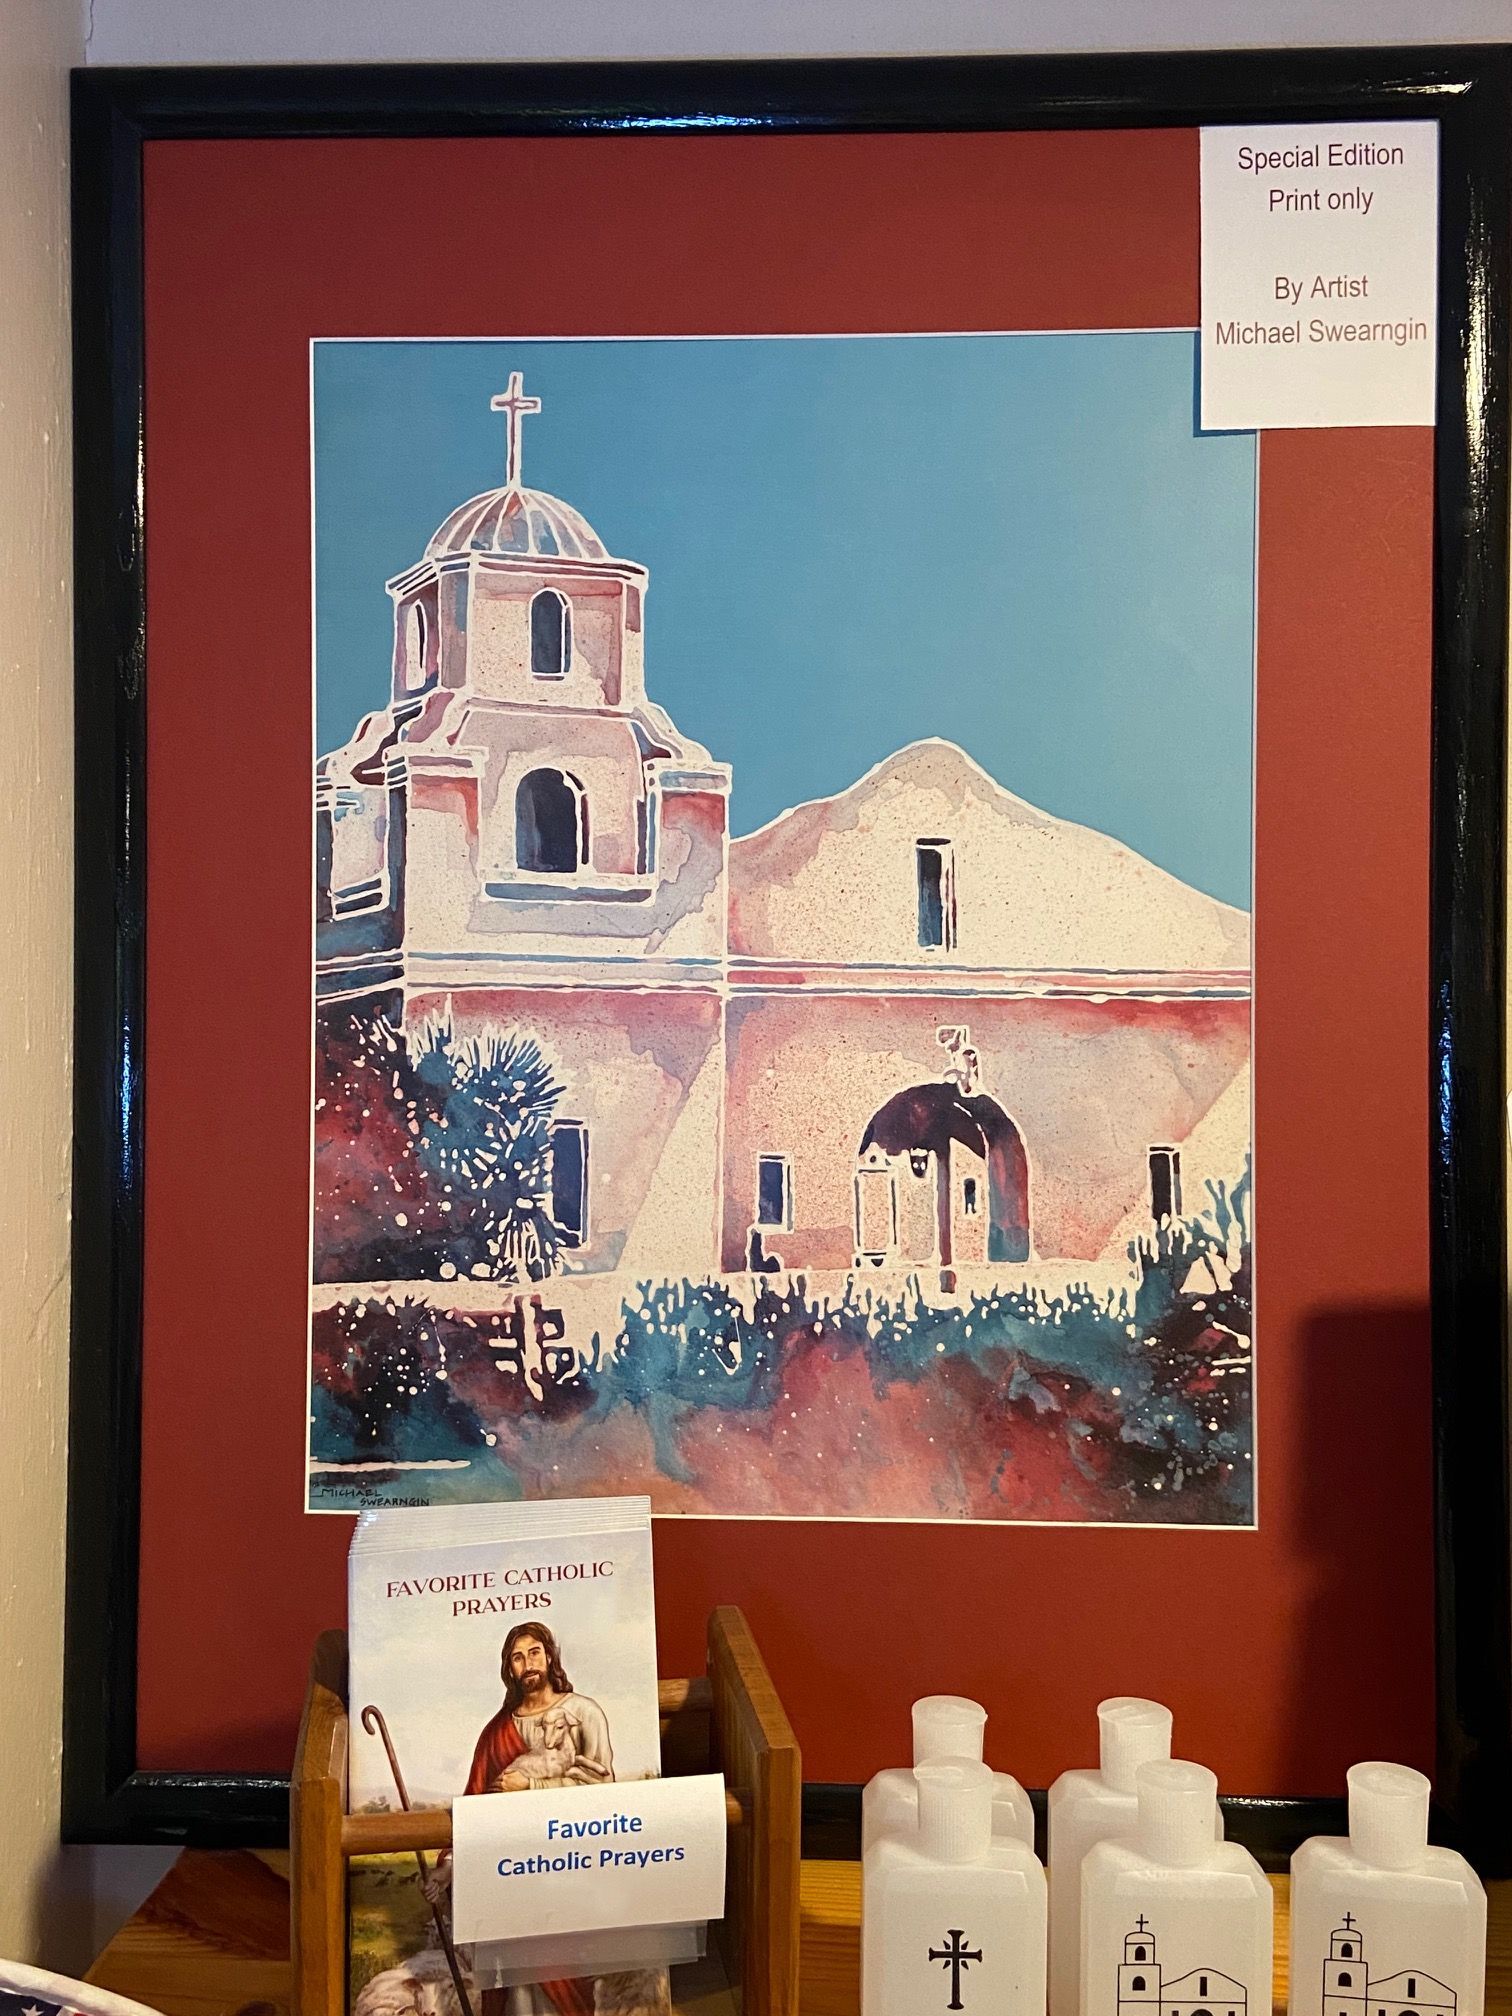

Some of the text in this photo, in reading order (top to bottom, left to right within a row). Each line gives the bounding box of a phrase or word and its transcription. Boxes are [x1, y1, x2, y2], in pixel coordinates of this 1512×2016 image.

[1238, 142, 1404, 175] Special Edition
[1269, 186, 1374, 215] Print only
[1275, 274, 1369, 305] By Artist
[1216, 317, 1428, 347] Michael Swearngin
[321, 1487, 383, 1498] MICHAEL
[360, 1496, 430, 1507] SWEARNGIN
[386, 1560, 614, 1598] FAVORITE CATHOLIC
[452, 1591, 552, 1617] PRAYERS
[547, 1813, 642, 1840] Favorite
[497, 1846, 685, 1877] Catholic Prayers
